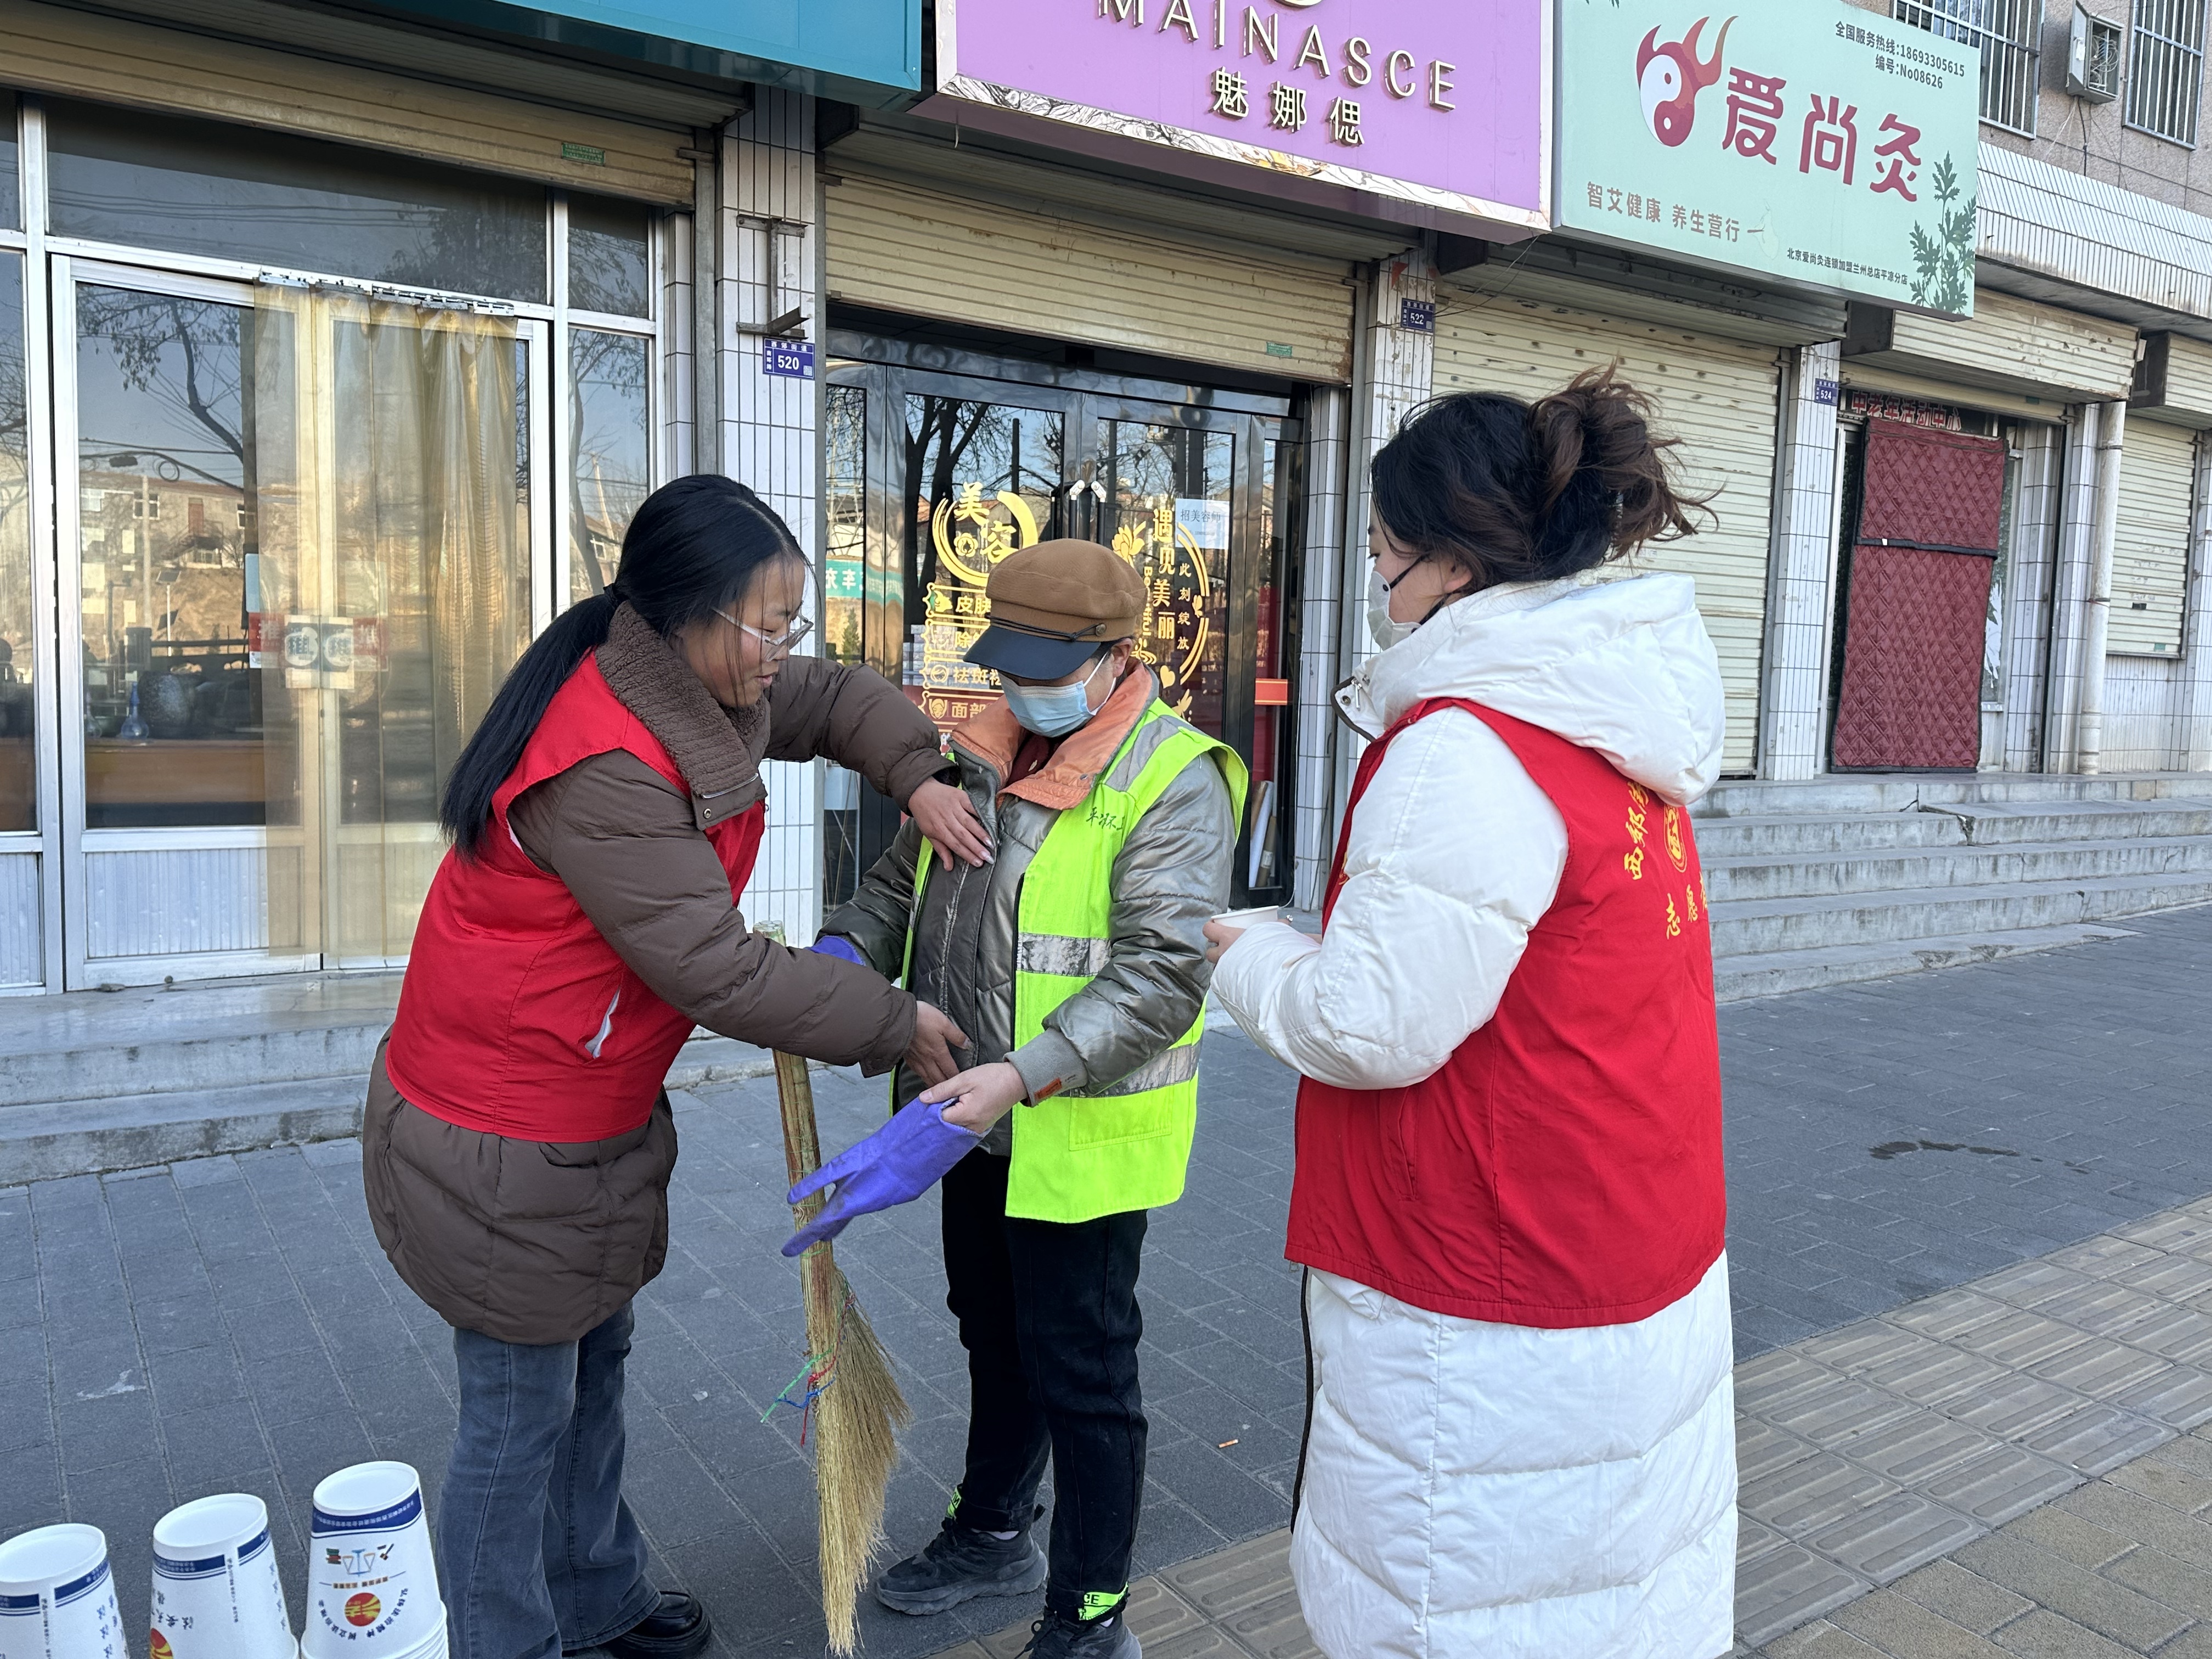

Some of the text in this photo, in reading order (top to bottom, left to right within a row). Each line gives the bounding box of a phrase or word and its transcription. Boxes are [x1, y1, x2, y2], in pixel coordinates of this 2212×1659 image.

[1835, 21, 1965, 77] 全国服务热线:18693305615
[1875, 54, 1943, 89] 编号:No08626
[1211, 66, 1365, 146] 魅娜偲
[1723, 67, 1922, 202] 爱尚灸
[1587, 182, 1740, 242] 智艾健康 养生营行
[1410, 313, 1424, 325] 522
[777, 355, 799, 370] 520
[1820, 390, 1832, 400] 524
[953, 481, 1019, 563] 美容
[1181, 509, 1221, 523] 招美容师
[1143, 566, 1153, 636] Betiful
[1153, 509, 1176, 639] 遇见美丽
[1177, 563, 1192, 650] 此刻绽放
